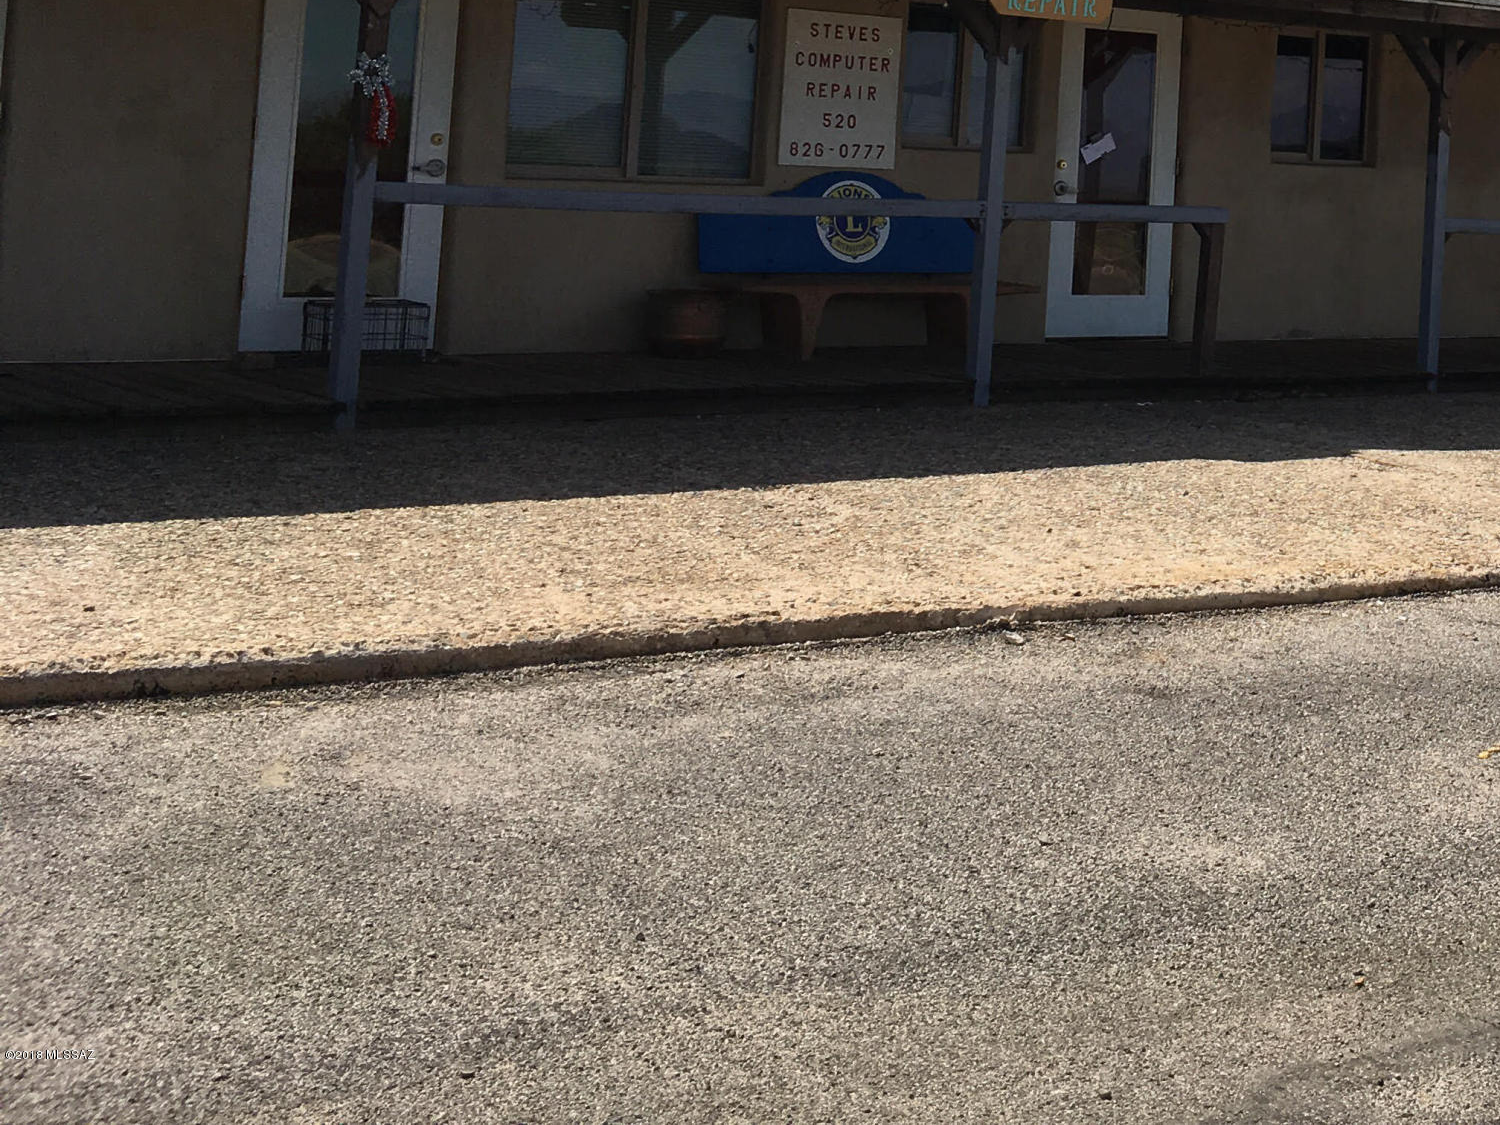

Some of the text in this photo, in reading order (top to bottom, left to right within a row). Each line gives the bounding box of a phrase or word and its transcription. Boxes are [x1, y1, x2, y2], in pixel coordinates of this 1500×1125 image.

[810, 22, 881, 42] STEVES
[795, 51, 891, 73] COMPUTER
[806, 82, 877, 101] REPAIR
[822, 112, 857, 129] 520
[789, 141, 886, 160] 826-0777
[830, 187, 871, 199] ION
